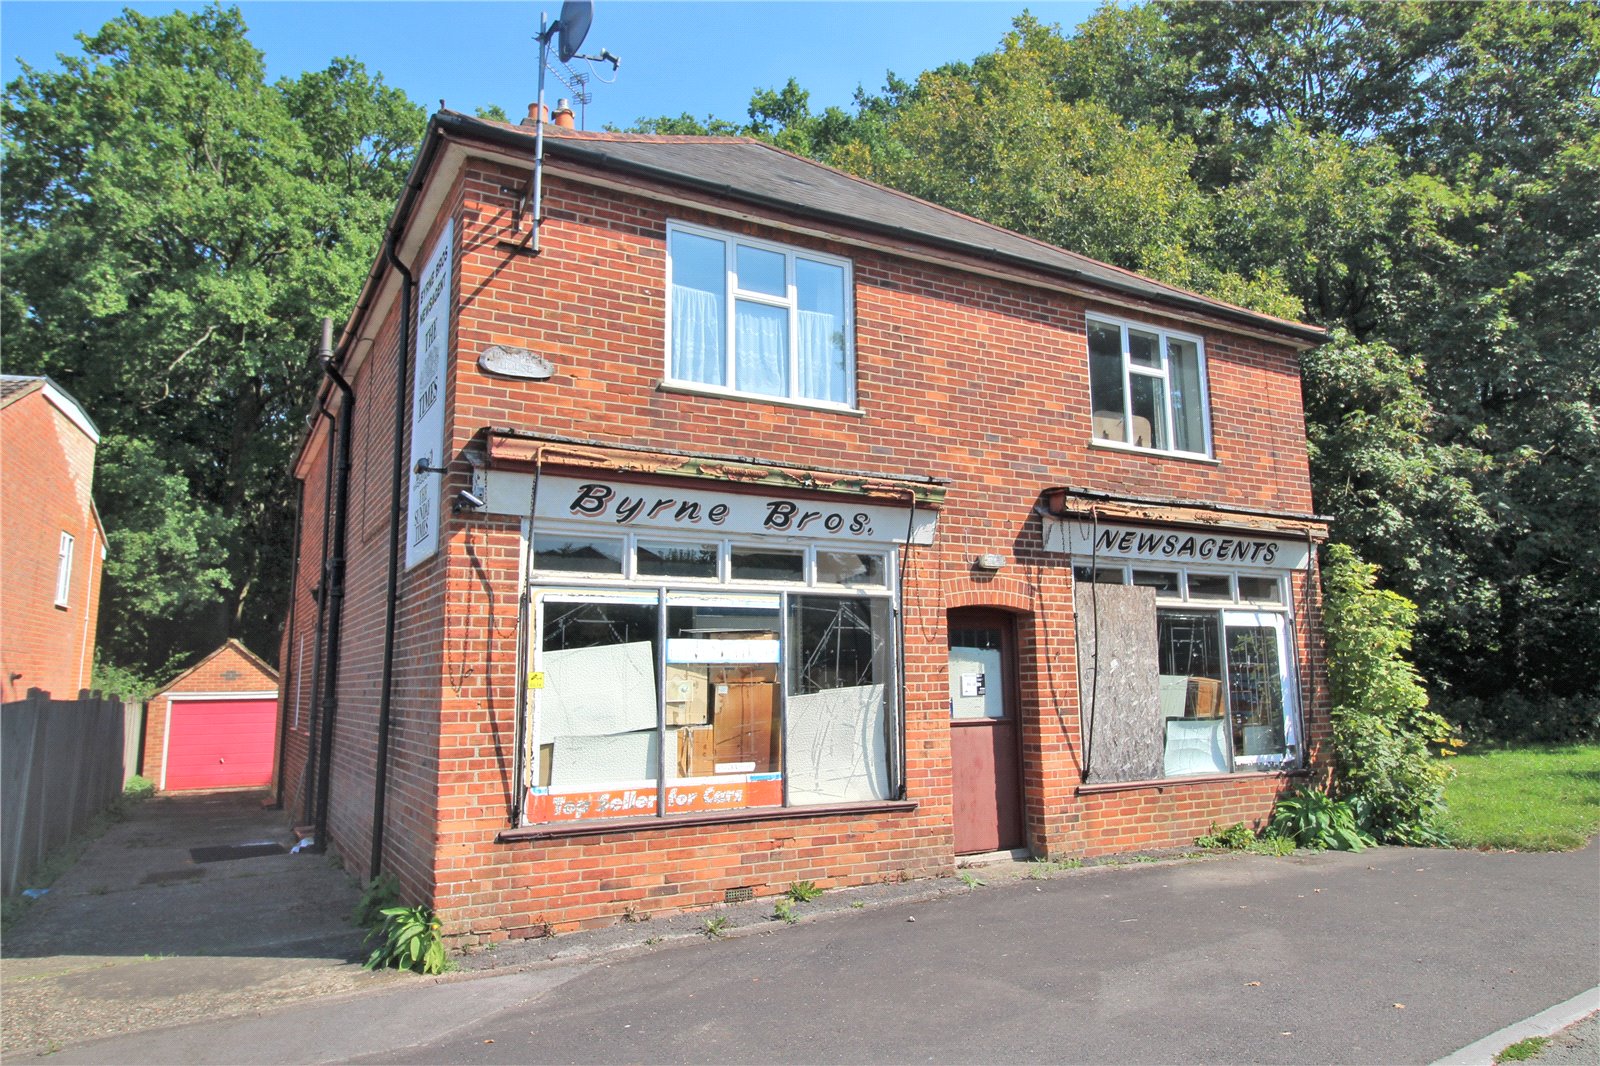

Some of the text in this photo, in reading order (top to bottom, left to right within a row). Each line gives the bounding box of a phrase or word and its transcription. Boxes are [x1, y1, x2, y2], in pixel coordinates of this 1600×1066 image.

[425, 316, 438, 352] THE
[418, 375, 438, 419] TIMES
[569, 483, 874, 535] Byrne Bros.
[1095, 529, 1280, 564] NEWSAGENTS
[553, 786, 744, 819] Top Seller for Cars
